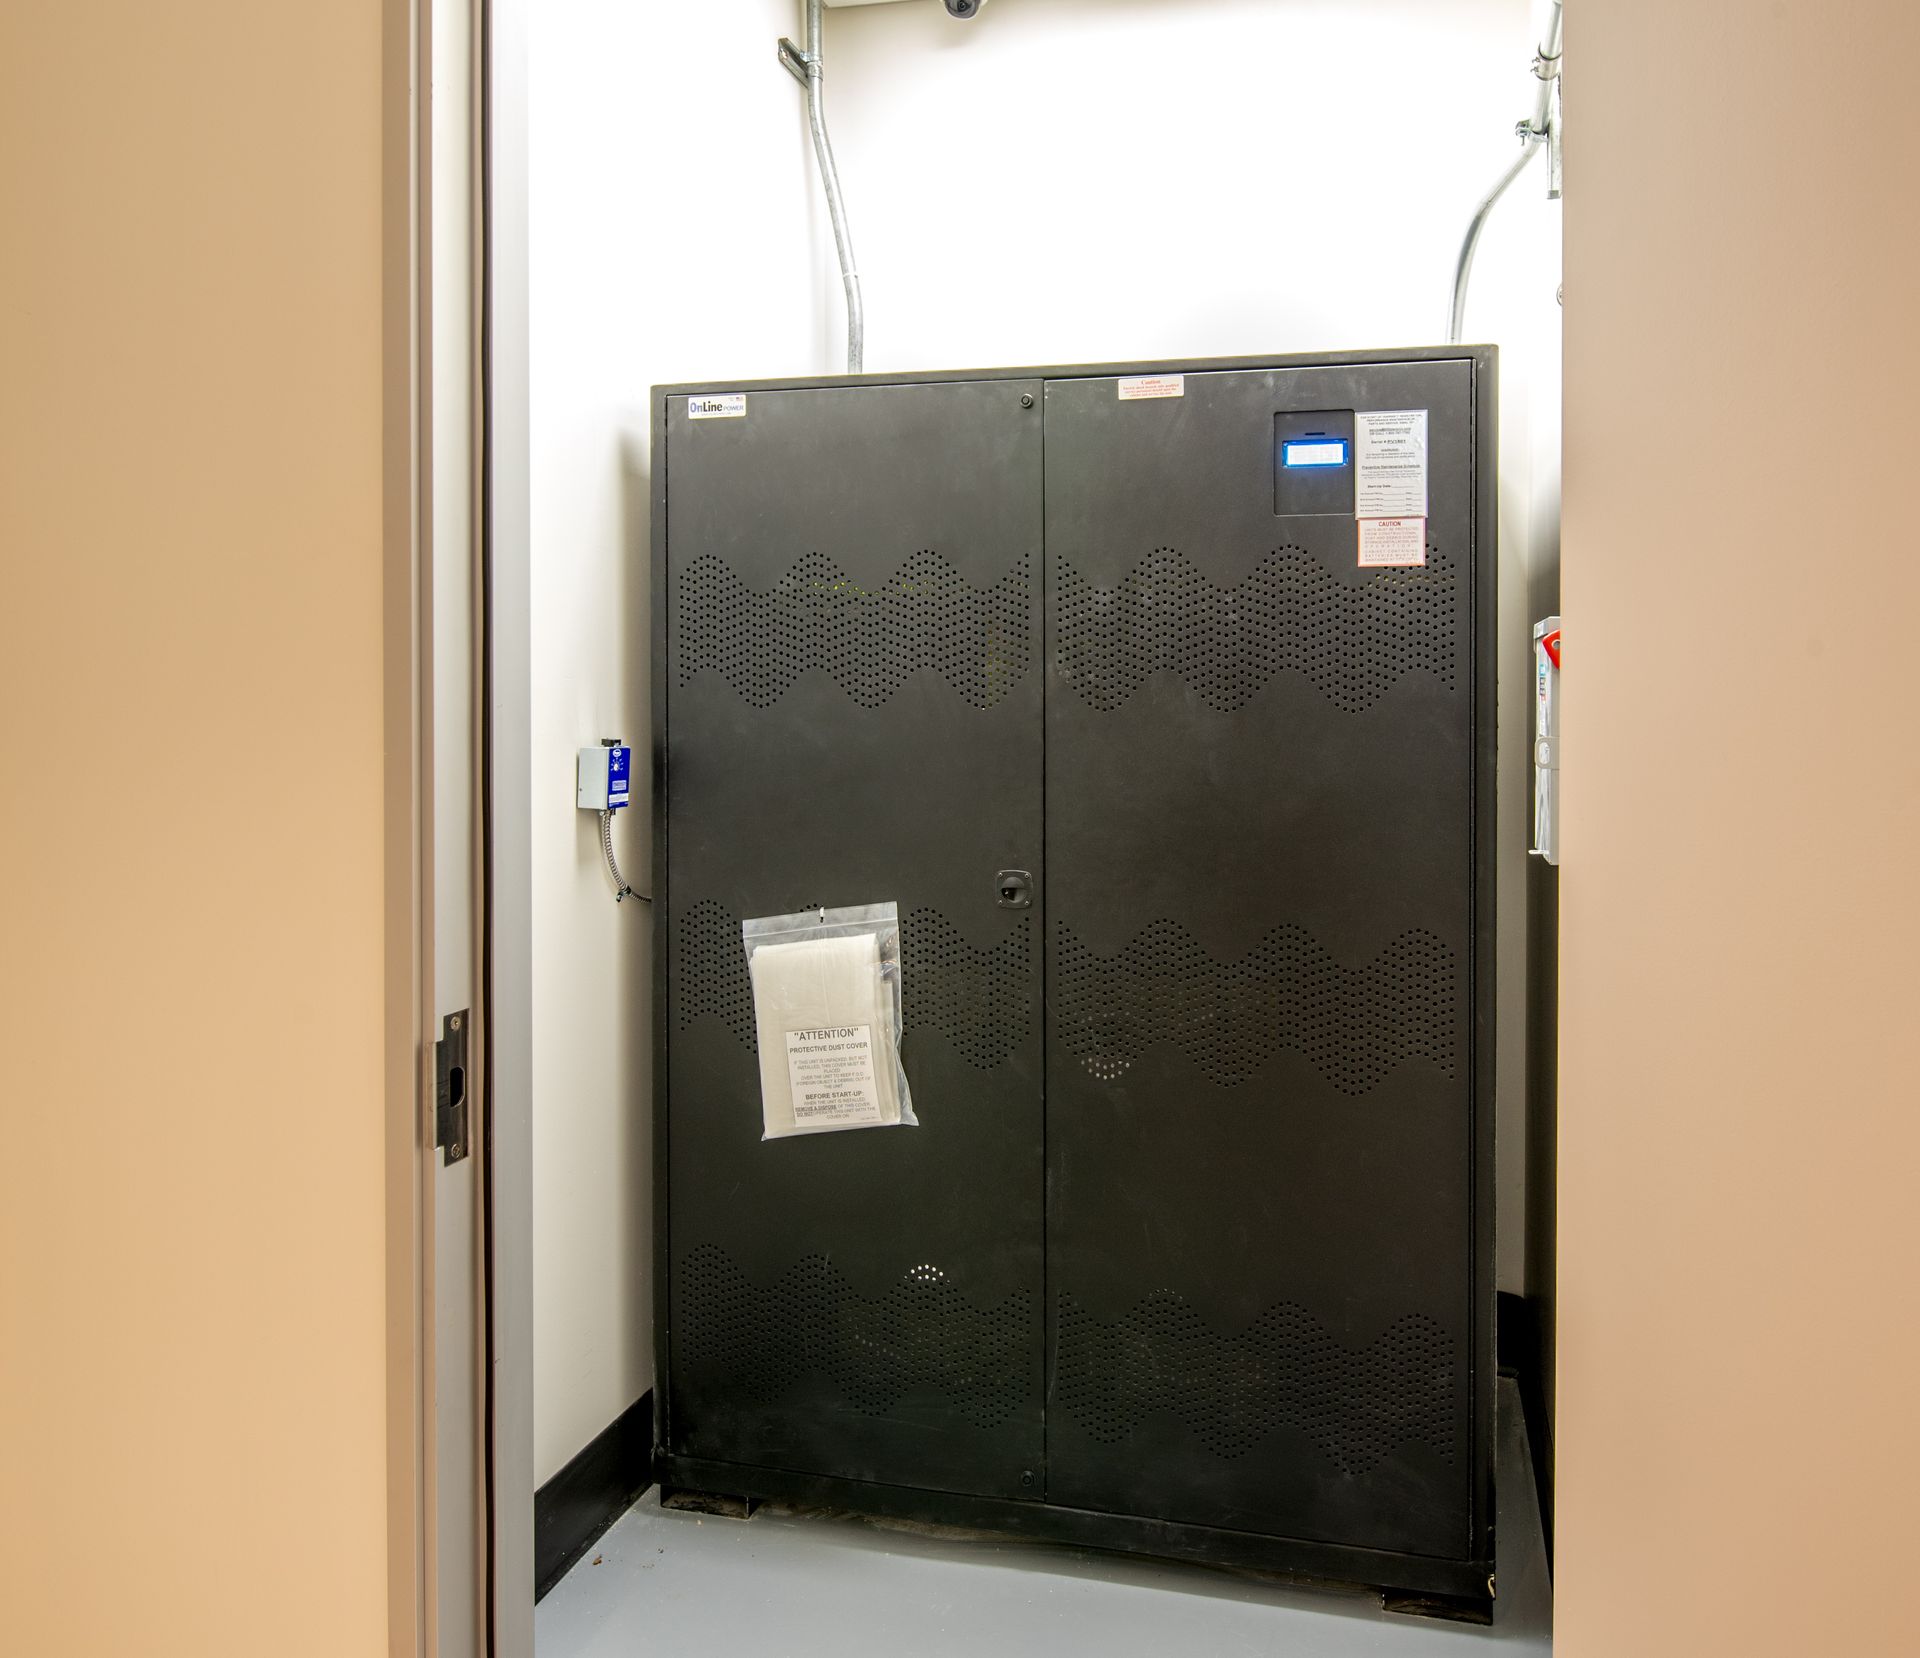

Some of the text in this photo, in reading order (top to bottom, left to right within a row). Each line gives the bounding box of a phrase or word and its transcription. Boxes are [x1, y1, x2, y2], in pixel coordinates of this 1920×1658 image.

[690, 401, 723, 413] OnLine
[794, 1027, 859, 1040] "ATTENTION"
[789, 1045, 828, 1053] PROTECTIVE
[828, 1043, 845, 1051] DUST
[805, 1092, 831, 1100] BEFORE
